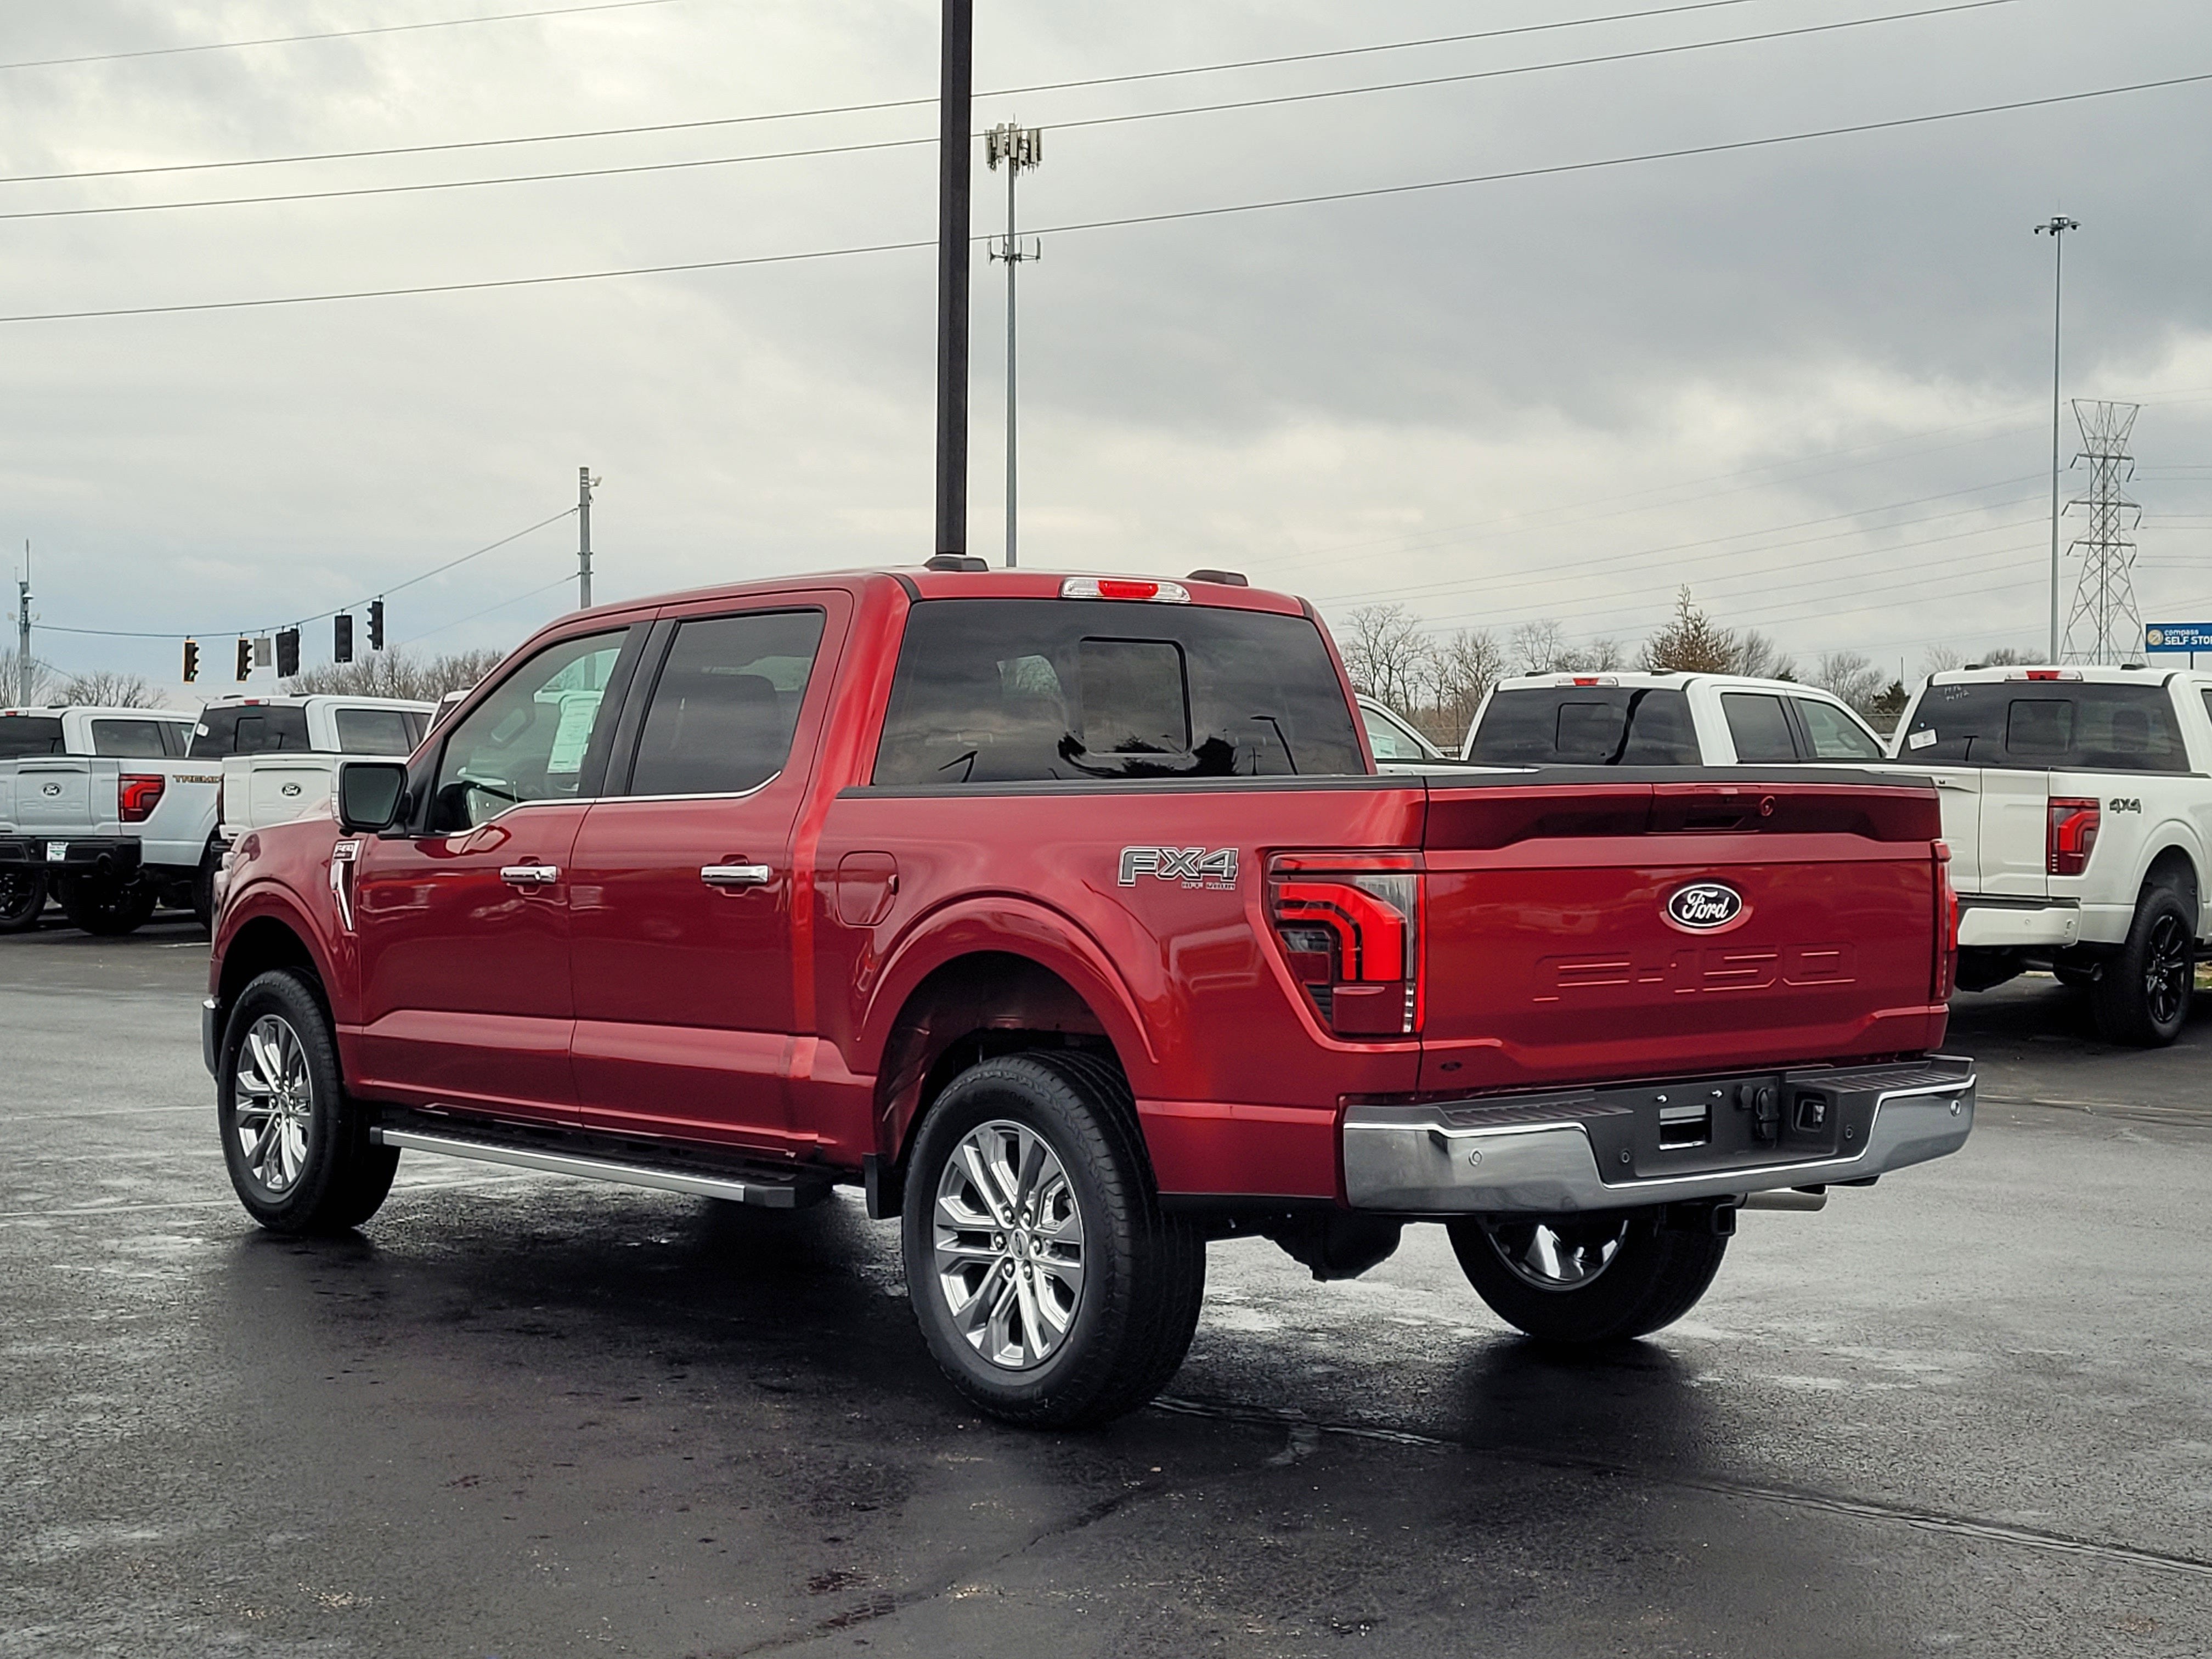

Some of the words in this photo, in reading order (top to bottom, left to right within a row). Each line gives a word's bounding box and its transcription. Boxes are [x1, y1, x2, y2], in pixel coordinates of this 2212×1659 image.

[2164, 636, 2189, 645] SELF
[1118, 847, 1238, 887] FX4
[1682, 890, 1730, 919] Ford
